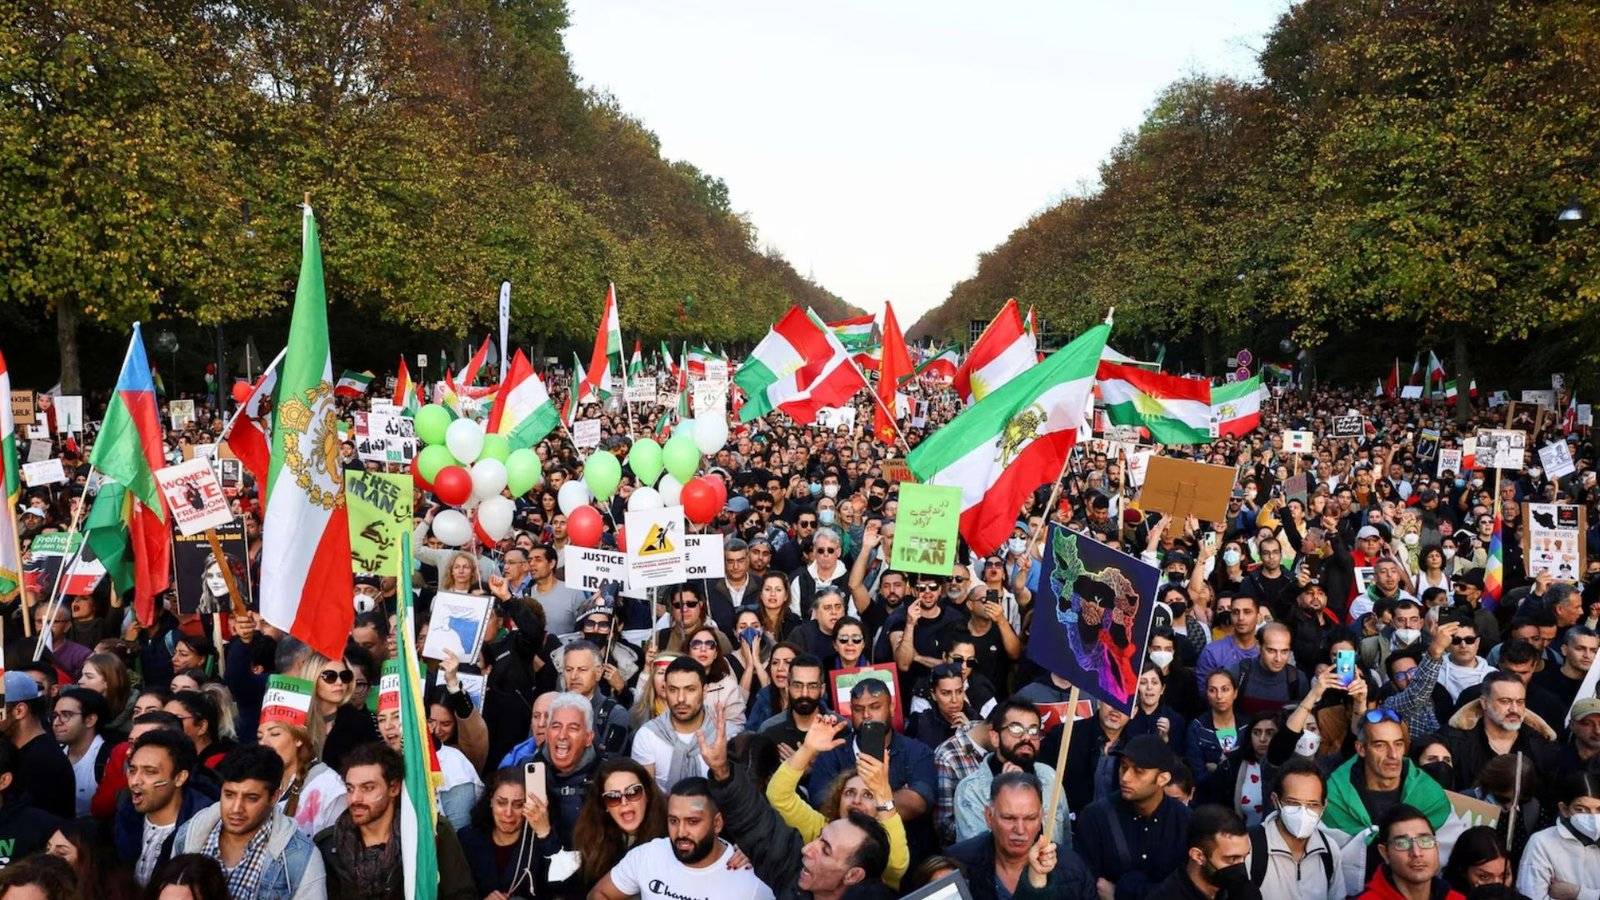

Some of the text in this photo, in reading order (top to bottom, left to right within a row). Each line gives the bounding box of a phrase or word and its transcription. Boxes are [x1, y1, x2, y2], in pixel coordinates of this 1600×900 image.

[162, 468, 212, 490] WOMEN
[361, 472, 401, 500] FREE
[169, 482, 221, 510] LE
[348, 476, 396, 514] IRAN
[176, 498, 224, 518] FREDOM
[581, 552, 624, 565] JUSTICE
[900, 546, 946, 565] IRAN
